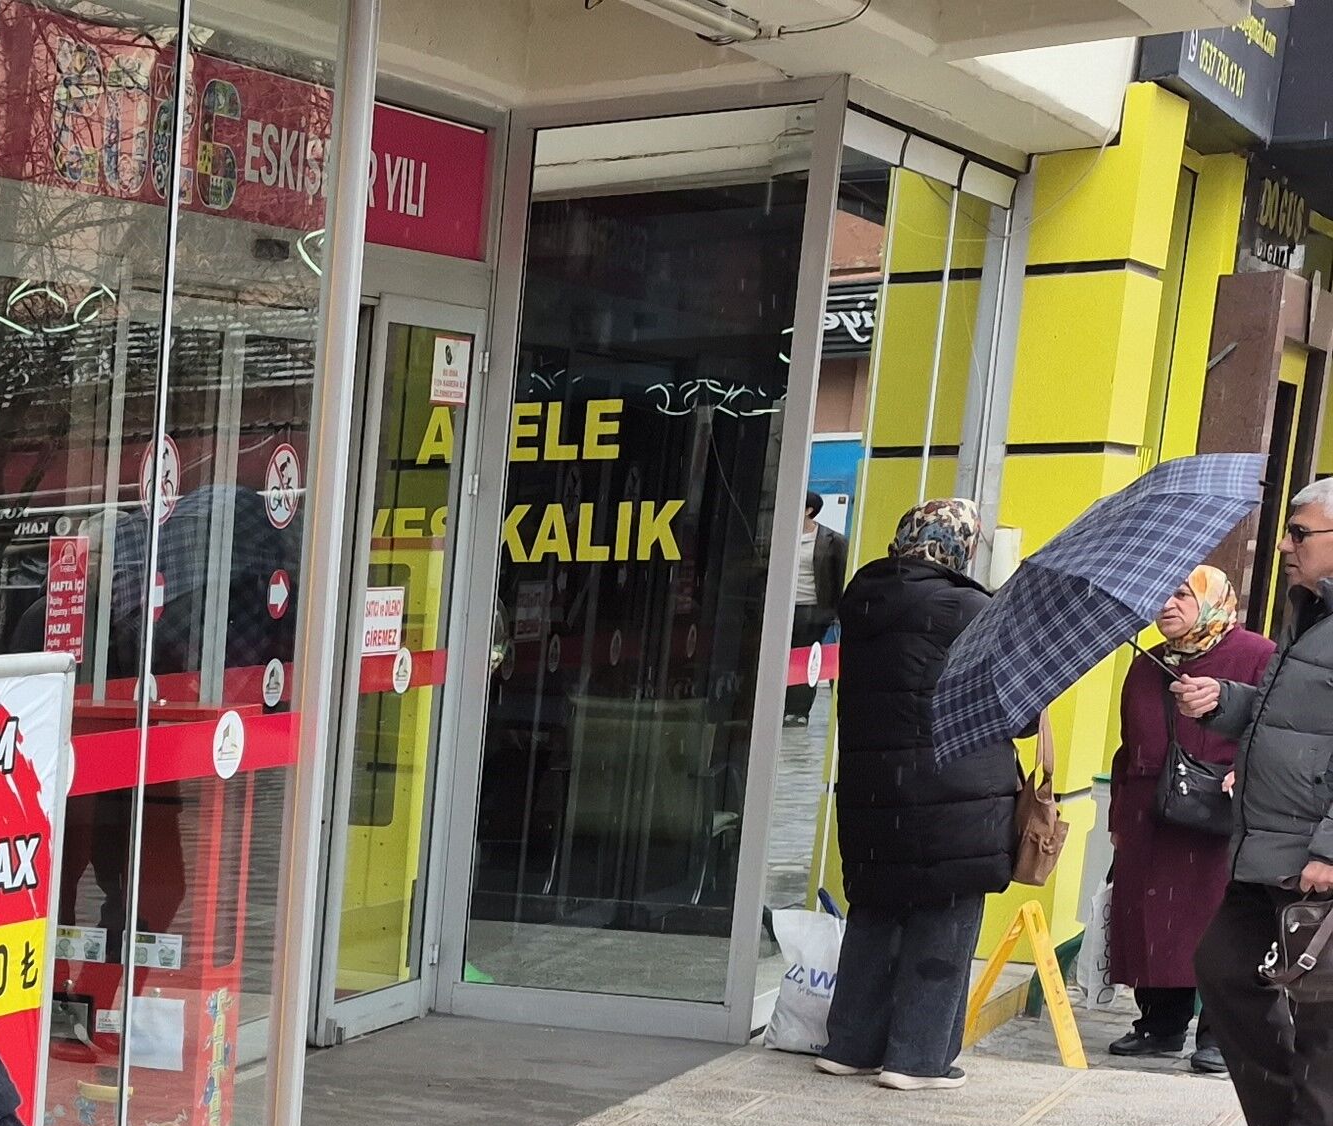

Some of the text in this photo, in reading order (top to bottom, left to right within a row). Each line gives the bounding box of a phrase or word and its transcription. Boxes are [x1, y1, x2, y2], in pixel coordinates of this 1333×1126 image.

[385, 153, 427, 217] YILI
[416, 398, 624, 465] AELE
[50, 581, 73, 593] HAFTA
[48, 623, 71, 635] PAZAR
[365, 627, 398, 647] GİREMEZ
[785, 963, 805, 984] LC
